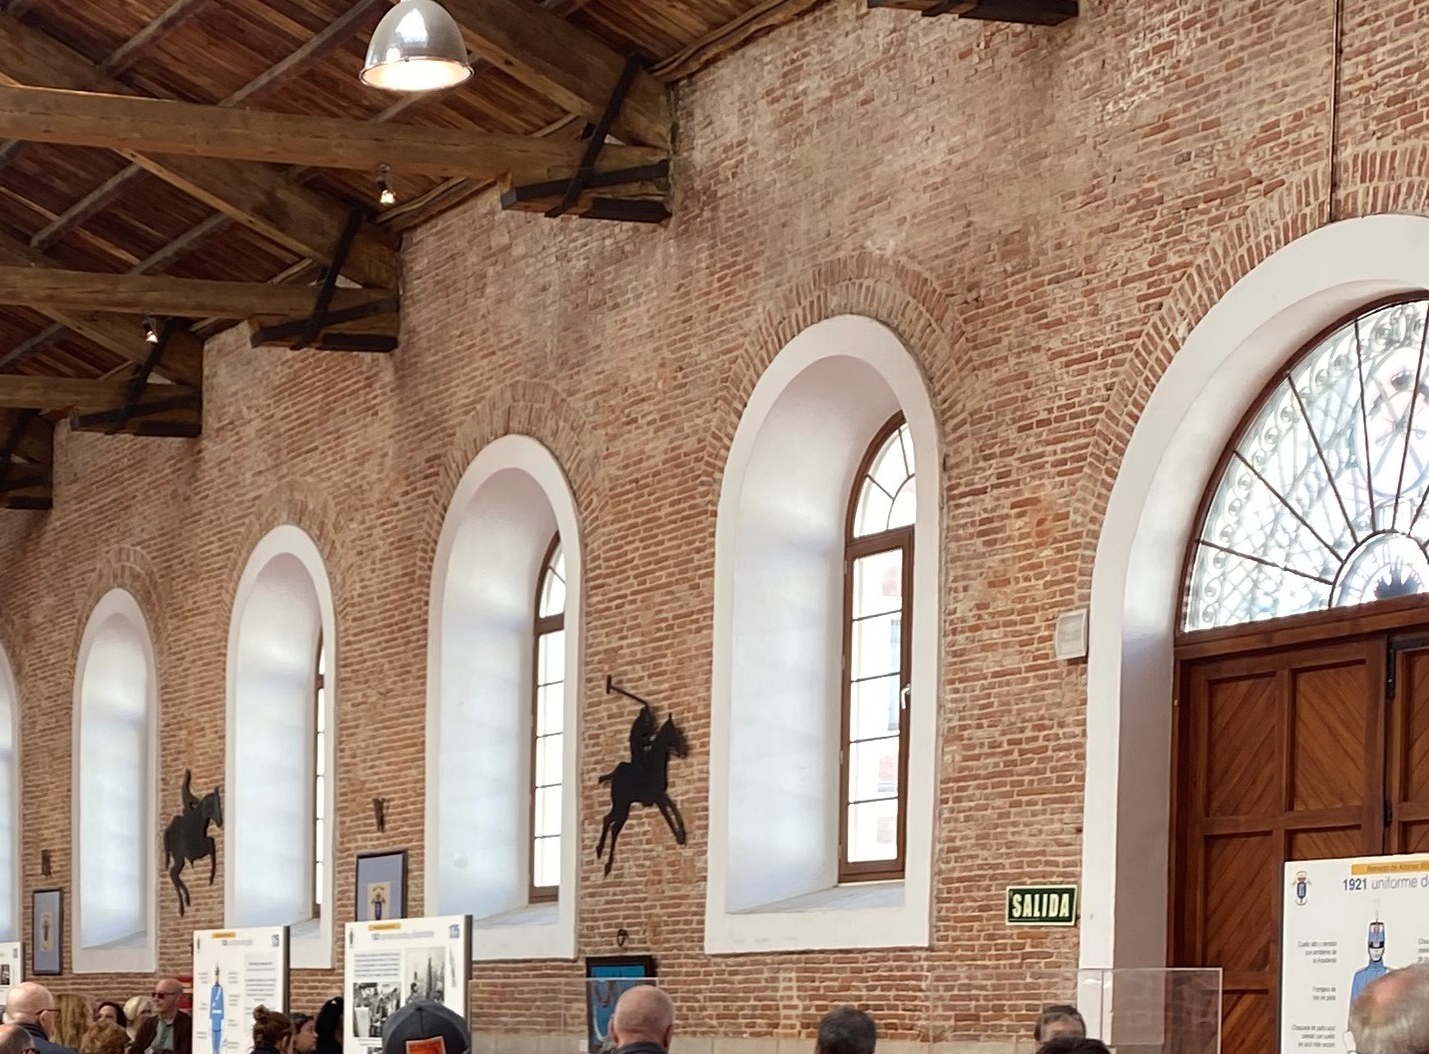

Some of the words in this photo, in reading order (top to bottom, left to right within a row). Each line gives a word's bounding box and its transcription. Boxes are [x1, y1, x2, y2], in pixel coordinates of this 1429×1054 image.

[1343, 878, 1367, 891] 1921
[1372, 876, 1418, 890] uniforme
[1012, 893, 1070, 918] SALIDA
